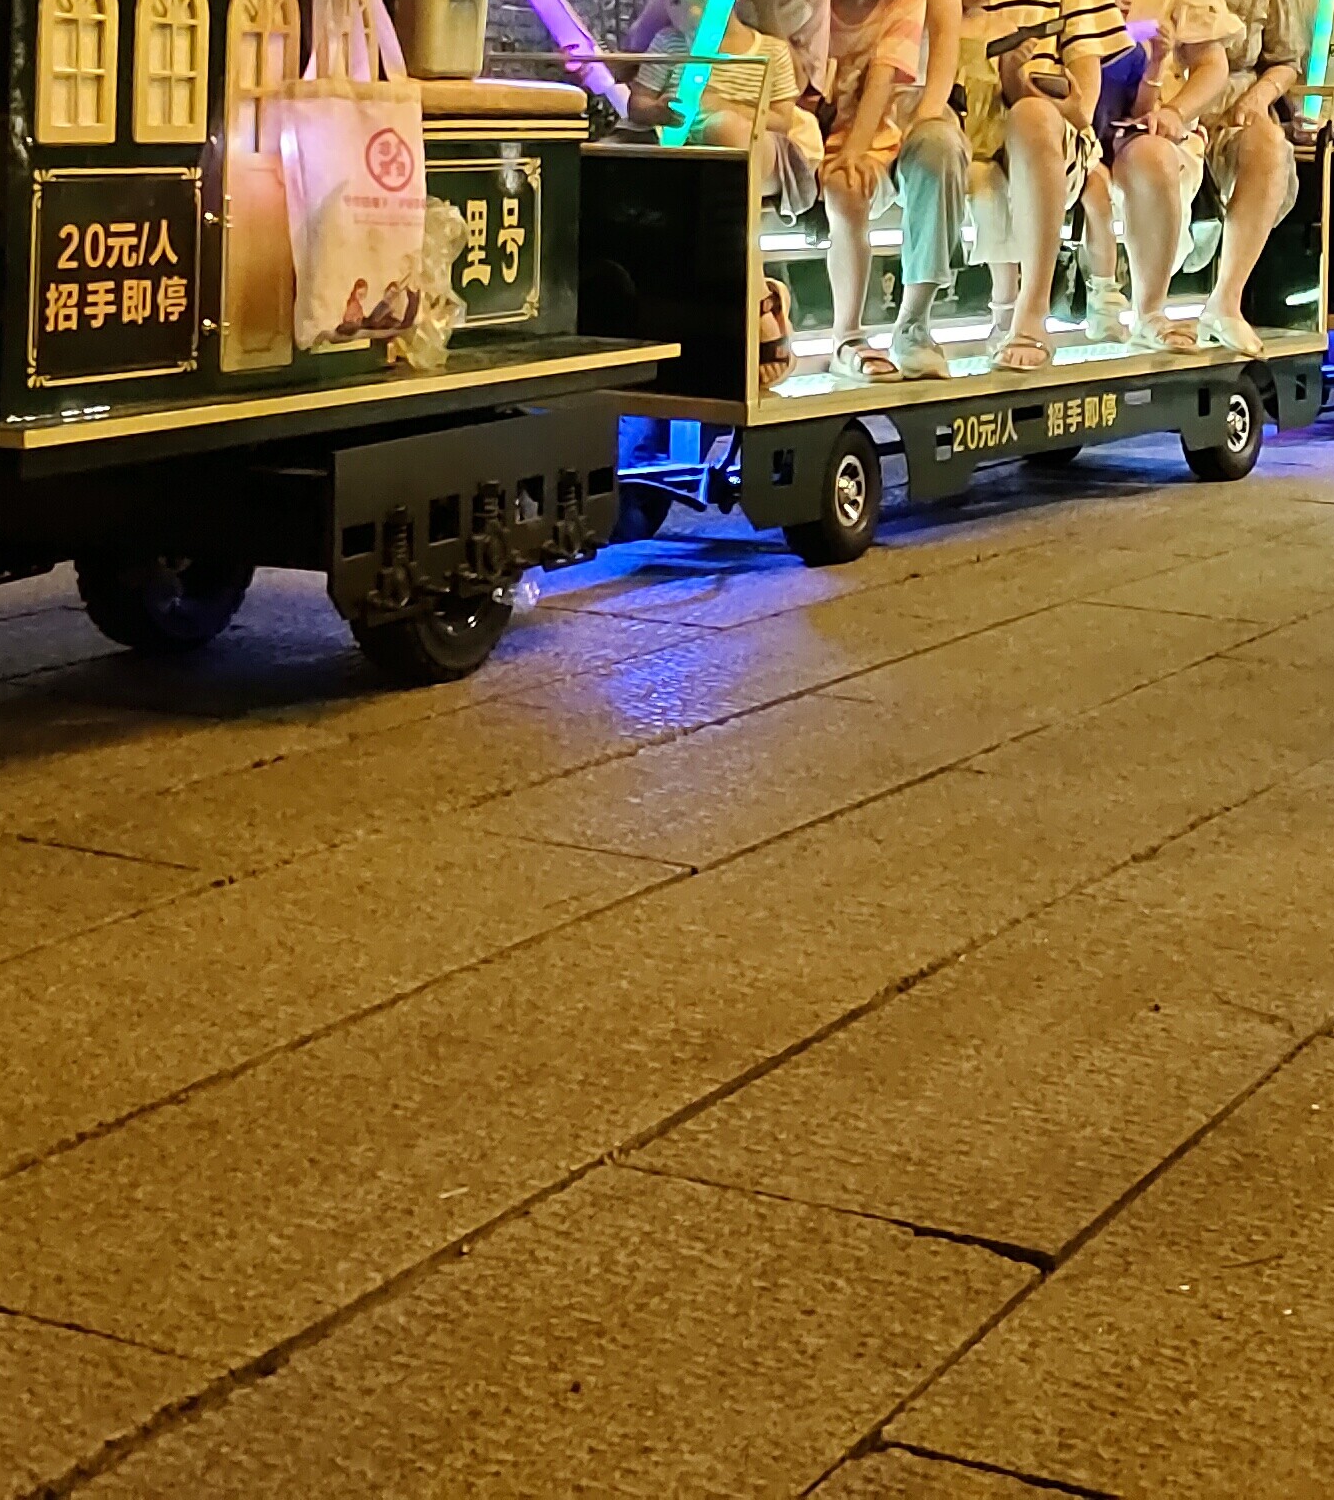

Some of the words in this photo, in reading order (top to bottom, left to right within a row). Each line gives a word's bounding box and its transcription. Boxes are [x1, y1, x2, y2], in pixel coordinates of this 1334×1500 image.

[57, 218, 179, 270] 20元/人
[447, 196, 526, 289] 里号
[45, 275, 188, 333] 招手即停
[953, 408, 1018, 452] 20元/人
[1047, 393, 1117, 438] 招手即停
